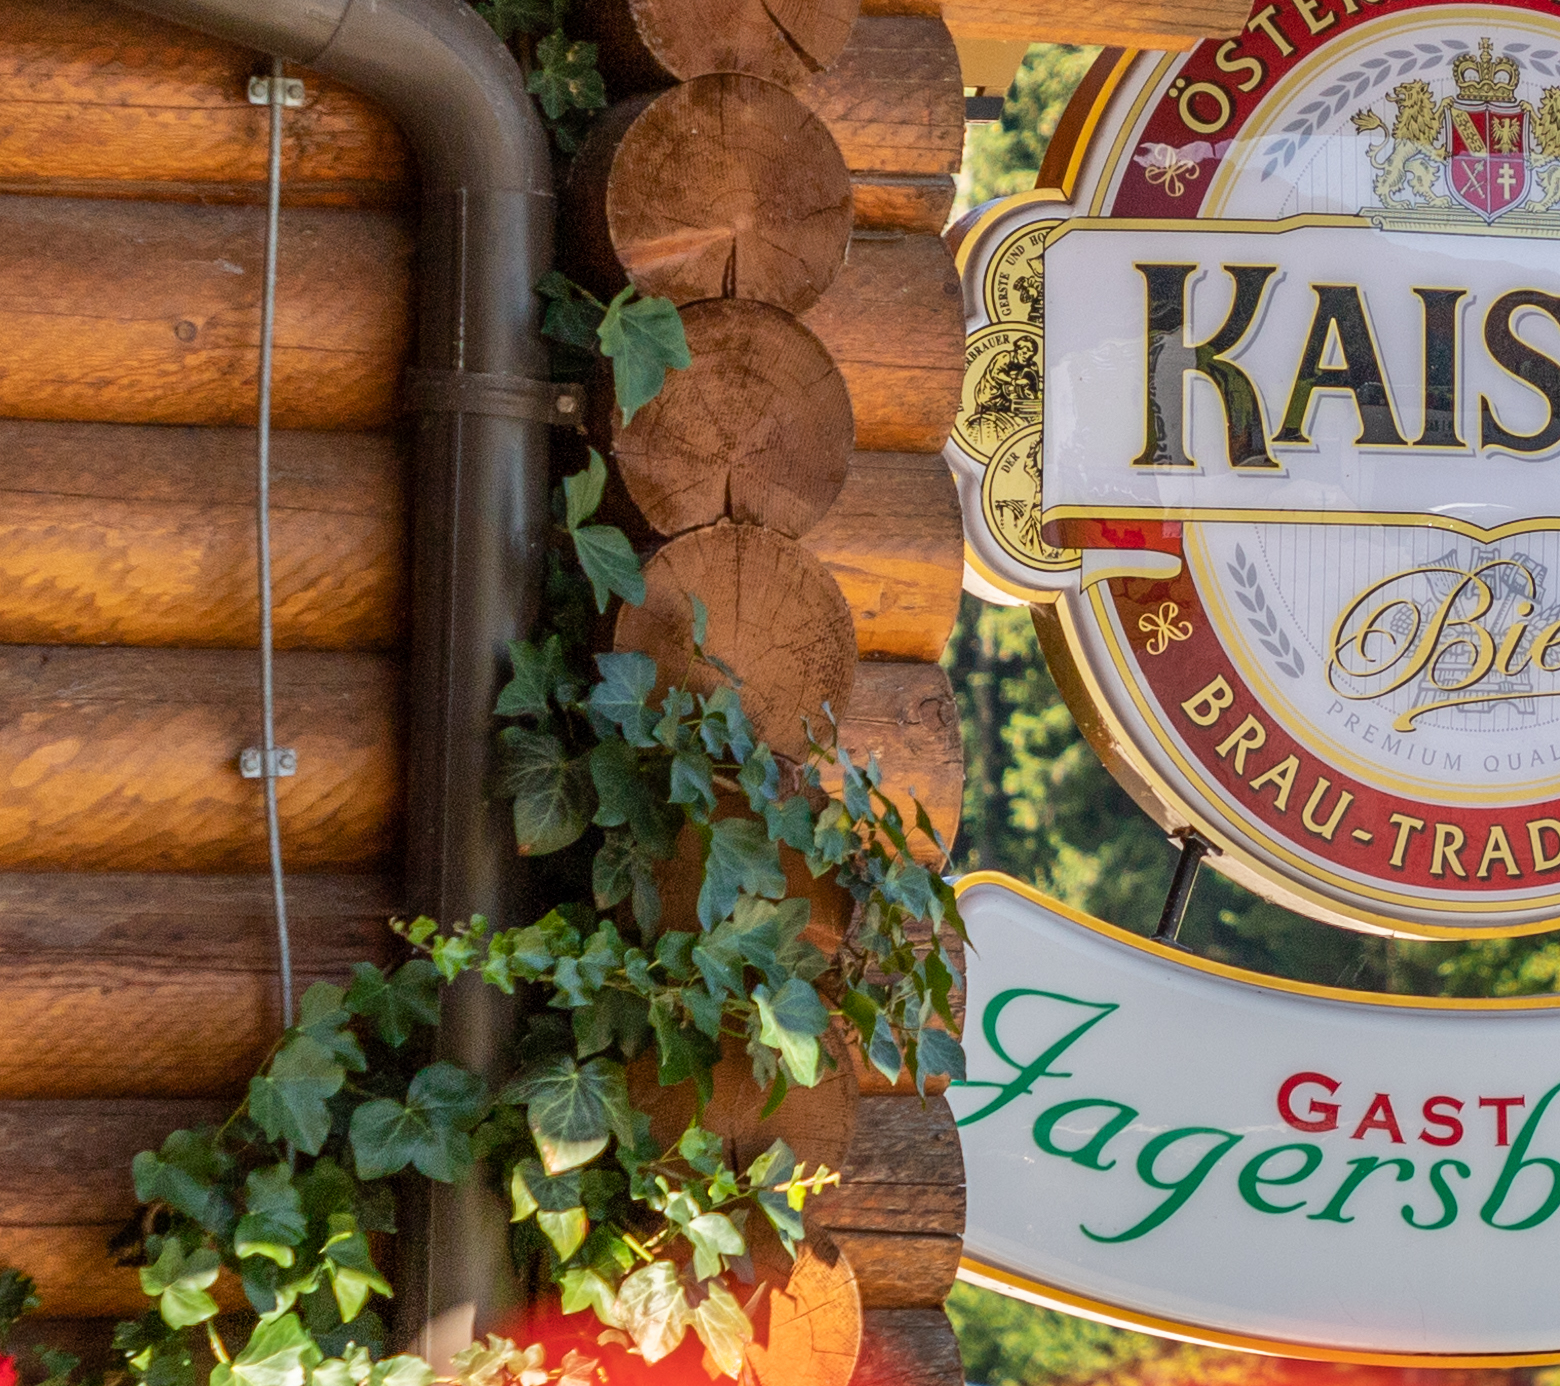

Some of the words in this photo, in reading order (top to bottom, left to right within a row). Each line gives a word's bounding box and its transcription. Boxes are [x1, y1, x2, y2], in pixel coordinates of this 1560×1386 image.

[997, 271, 1013, 317] GERSTE
[1005, 244, 1026, 267] UND
[1000, 451, 1021, 474] DER
[1325, 698, 1463, 772] PREMIUM
